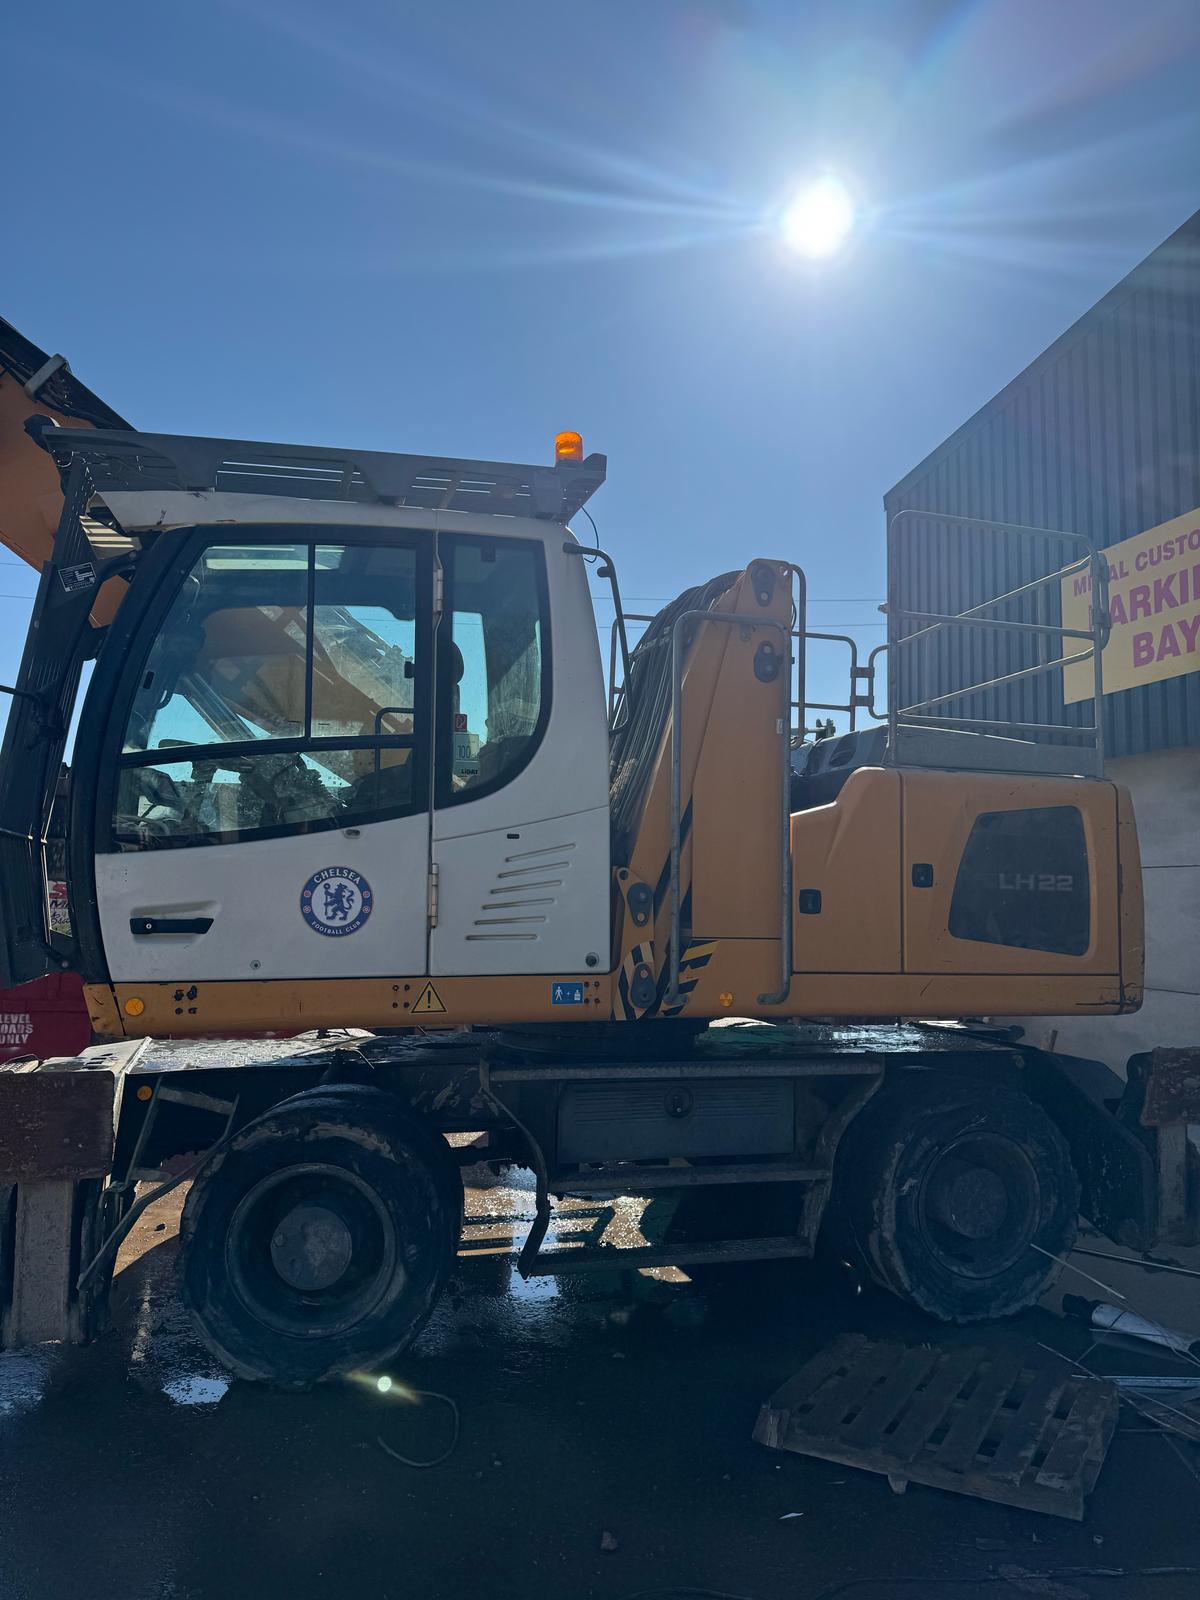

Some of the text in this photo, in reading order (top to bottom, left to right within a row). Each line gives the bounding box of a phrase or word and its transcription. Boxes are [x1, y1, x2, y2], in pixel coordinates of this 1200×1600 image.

[313, 868, 360, 884] CHELSEA
[999, 873, 1072, 891] LH22
[311, 920, 361, 934] FOOTBALL CLUB
